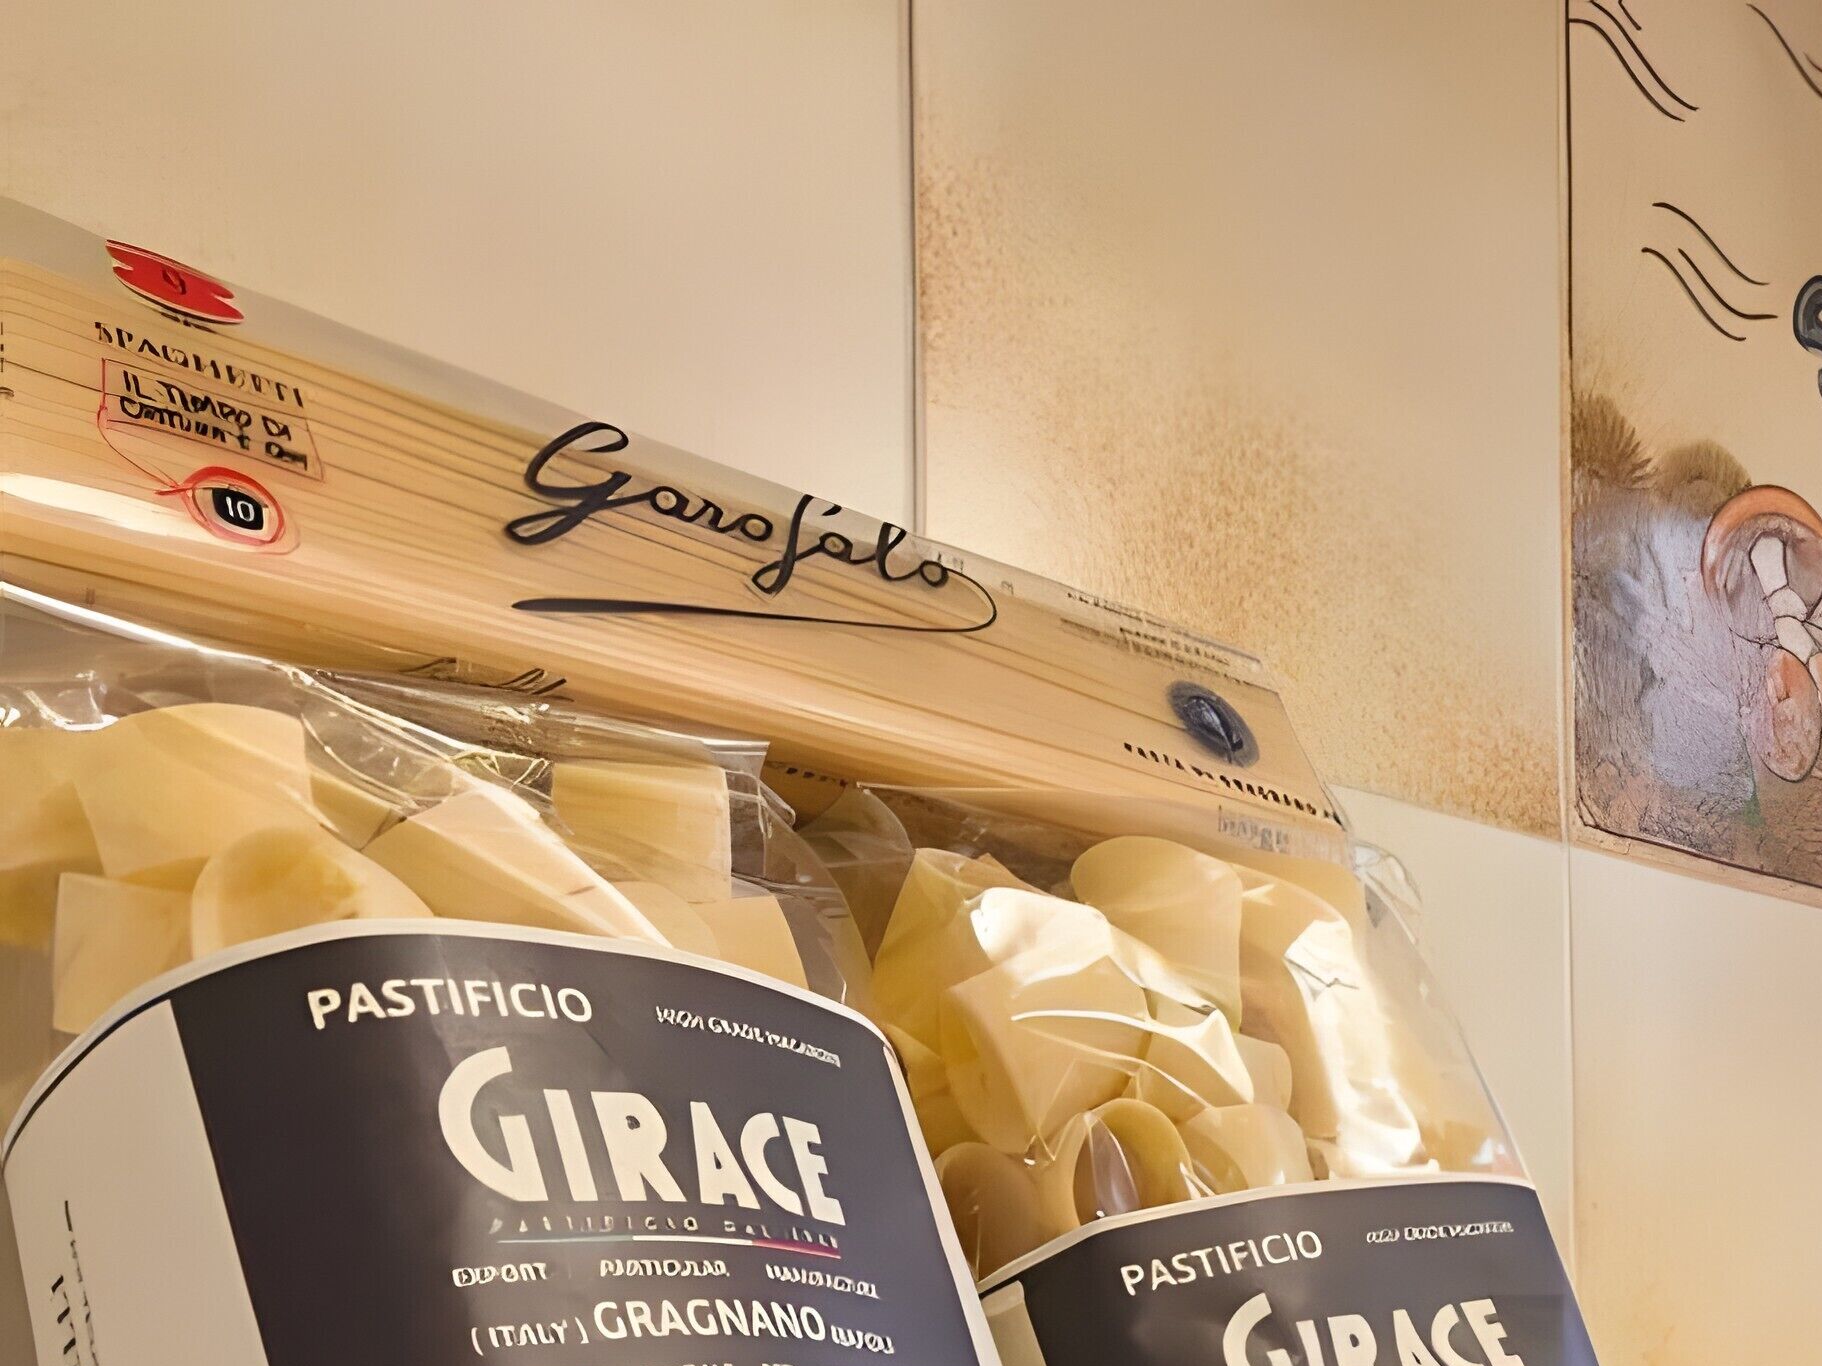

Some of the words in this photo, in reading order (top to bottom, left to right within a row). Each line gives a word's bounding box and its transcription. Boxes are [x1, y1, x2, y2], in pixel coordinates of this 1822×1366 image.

[225, 496, 255, 522] 10
[307, 977, 593, 1030] PASTIFICIO
[438, 1046, 845, 1226] GIRACE
[1121, 1230, 1324, 1297] PASTIFICIO
[593, 1299, 826, 1342] GRAGNANO
